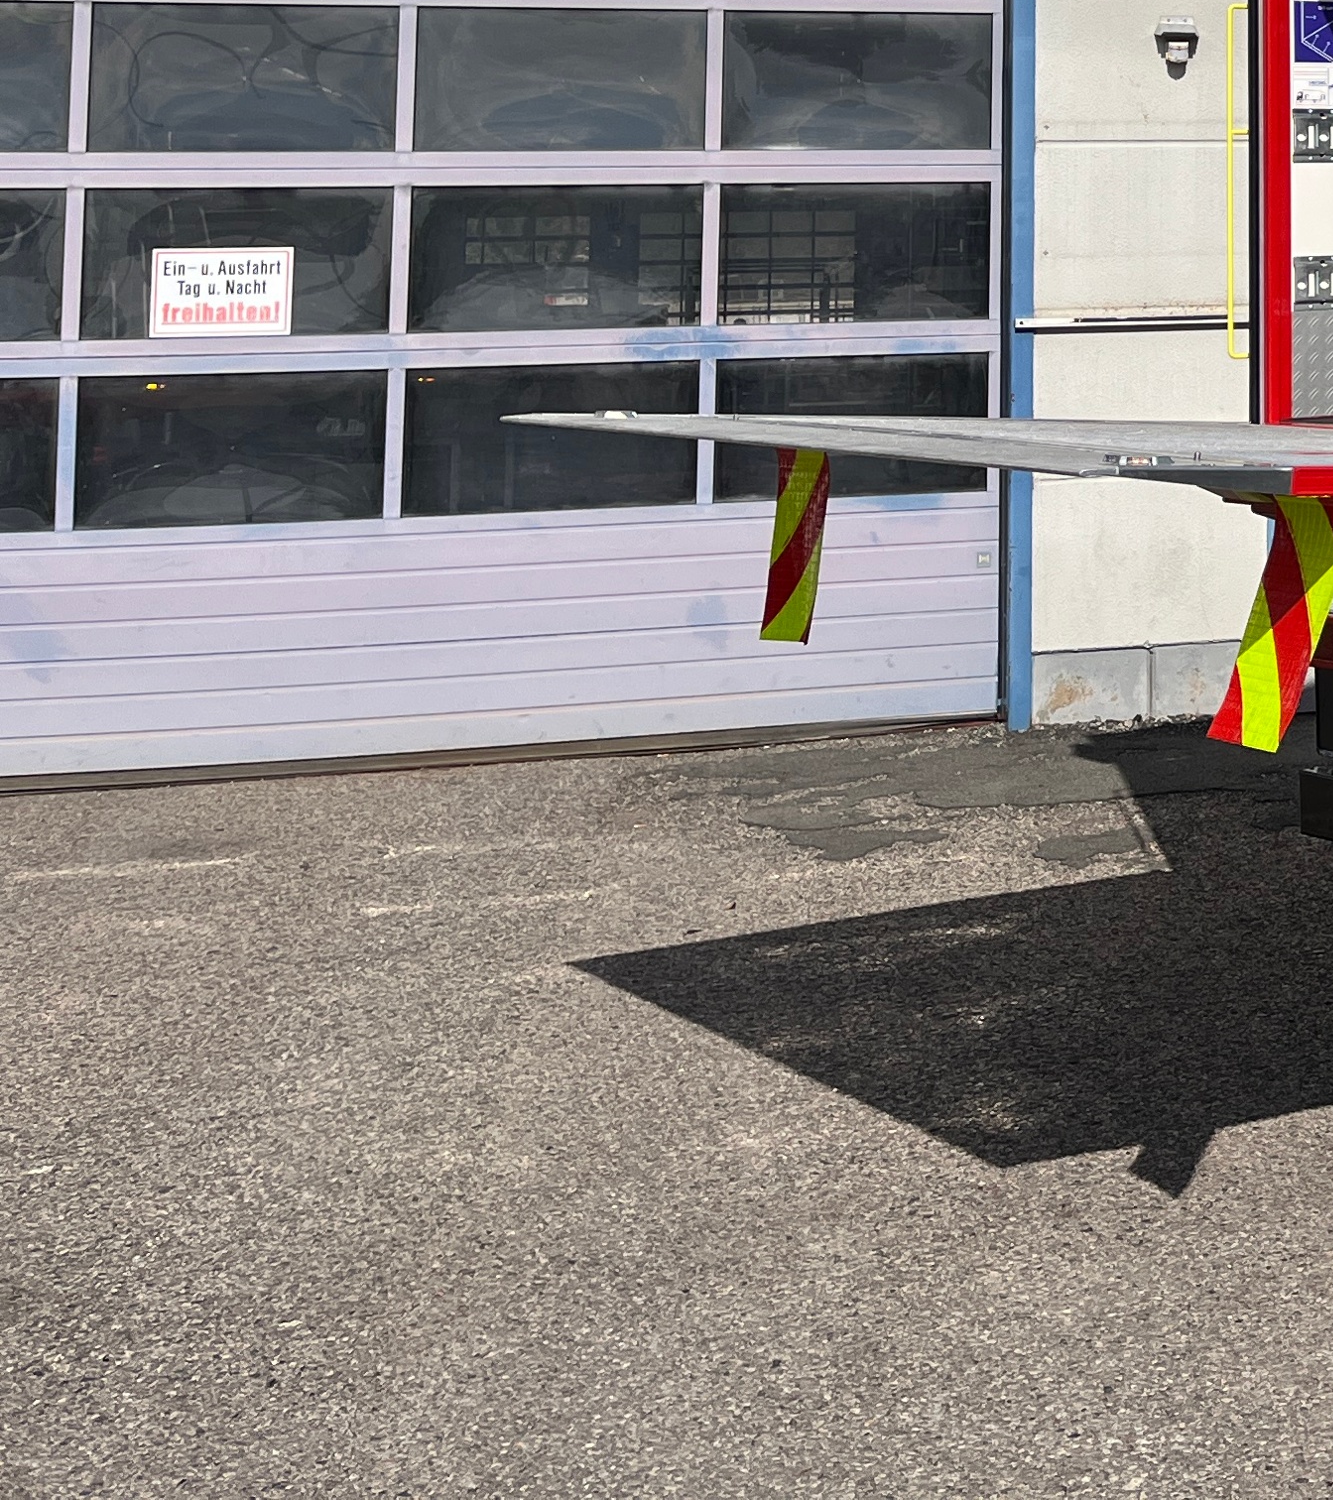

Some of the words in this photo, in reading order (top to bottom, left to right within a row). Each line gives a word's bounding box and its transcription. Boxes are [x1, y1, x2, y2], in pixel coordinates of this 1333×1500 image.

[201, 263, 214, 276] u.
[218, 260, 281, 276] Ausfahrt
[177, 280, 201, 298] Tag
[208, 283, 221, 296] u.
[225, 280, 267, 295] Nacht
[162, 301, 280, 324] freihalten!
